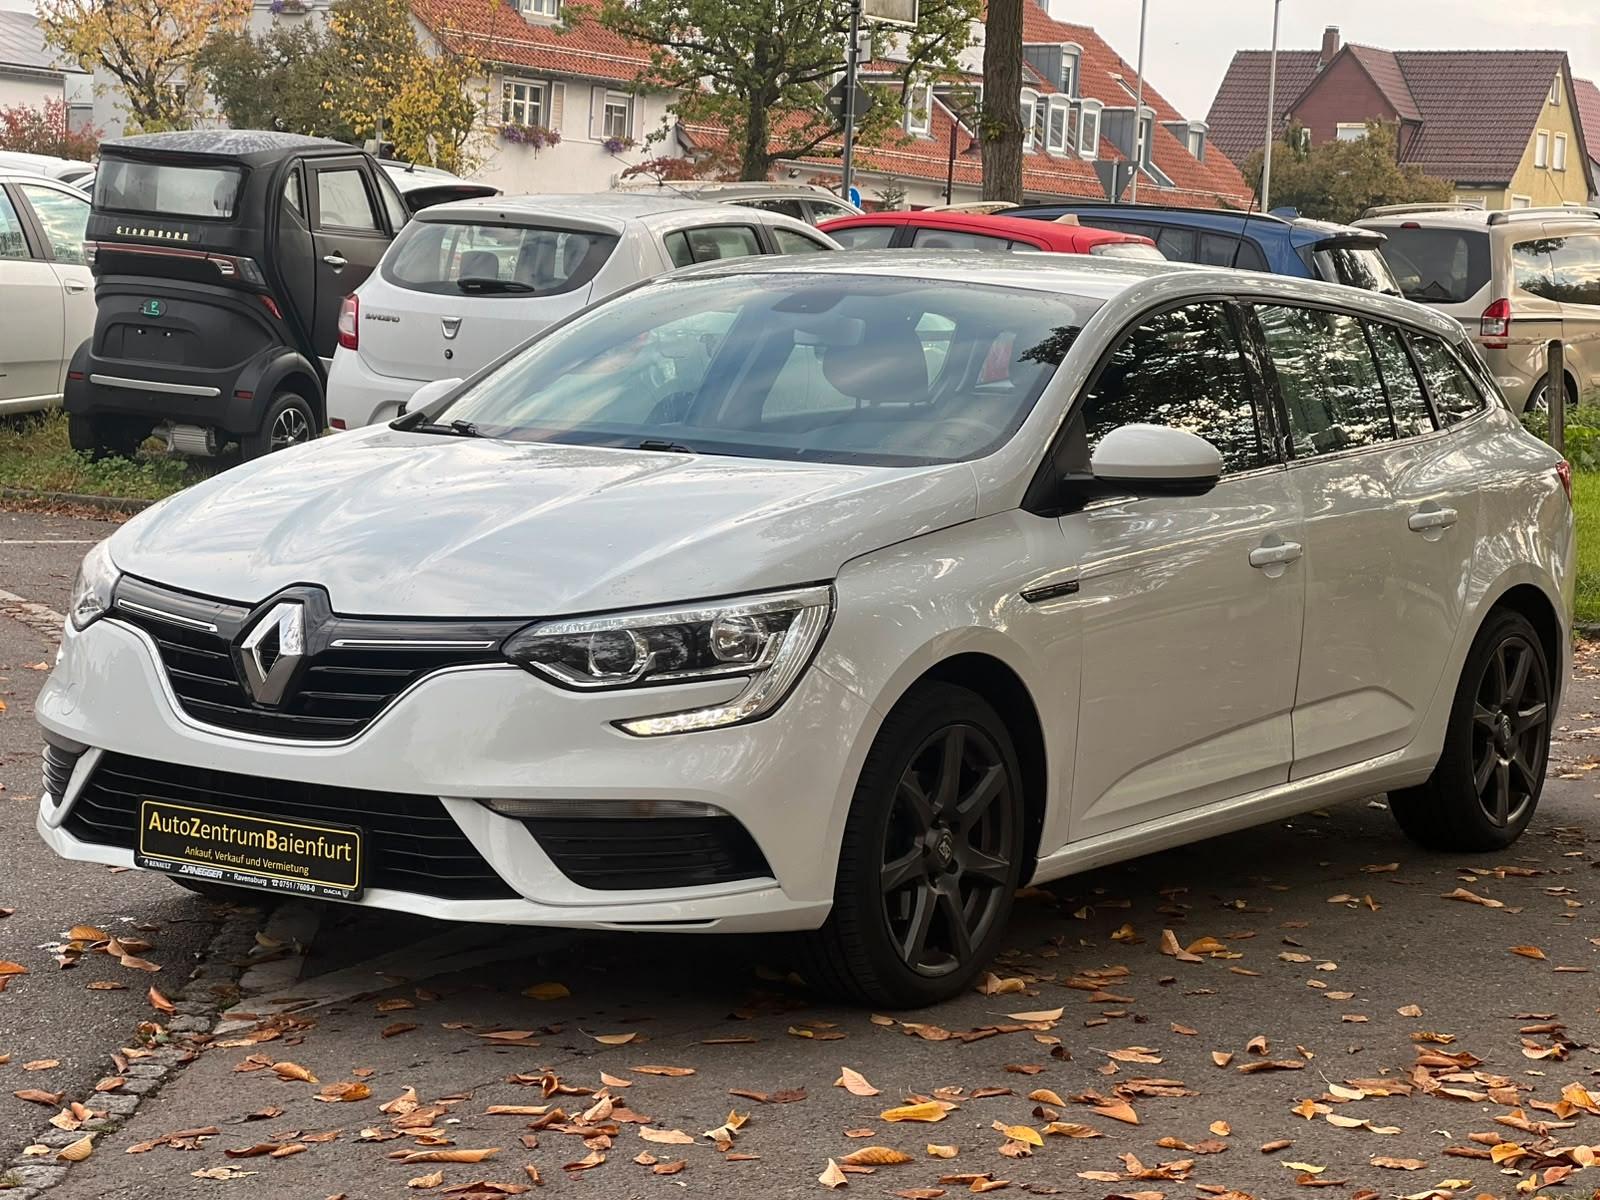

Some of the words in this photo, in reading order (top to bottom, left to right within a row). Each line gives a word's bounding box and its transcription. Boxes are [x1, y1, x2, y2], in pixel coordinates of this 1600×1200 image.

[148, 811, 352, 862] AutoZentrumBaienfurt
[149, 860, 172, 869] RENAULT
[178, 864, 223, 879] ARNEGGER
[233, 872, 268, 887] Ravensburg
[323, 888, 341, 896] DACIA
[184, 845, 213, 860] Ankauf,
[214, 850, 245, 864] Verkauf
[245, 857, 261, 867] und
[262, 858, 310, 877] Vermietung
